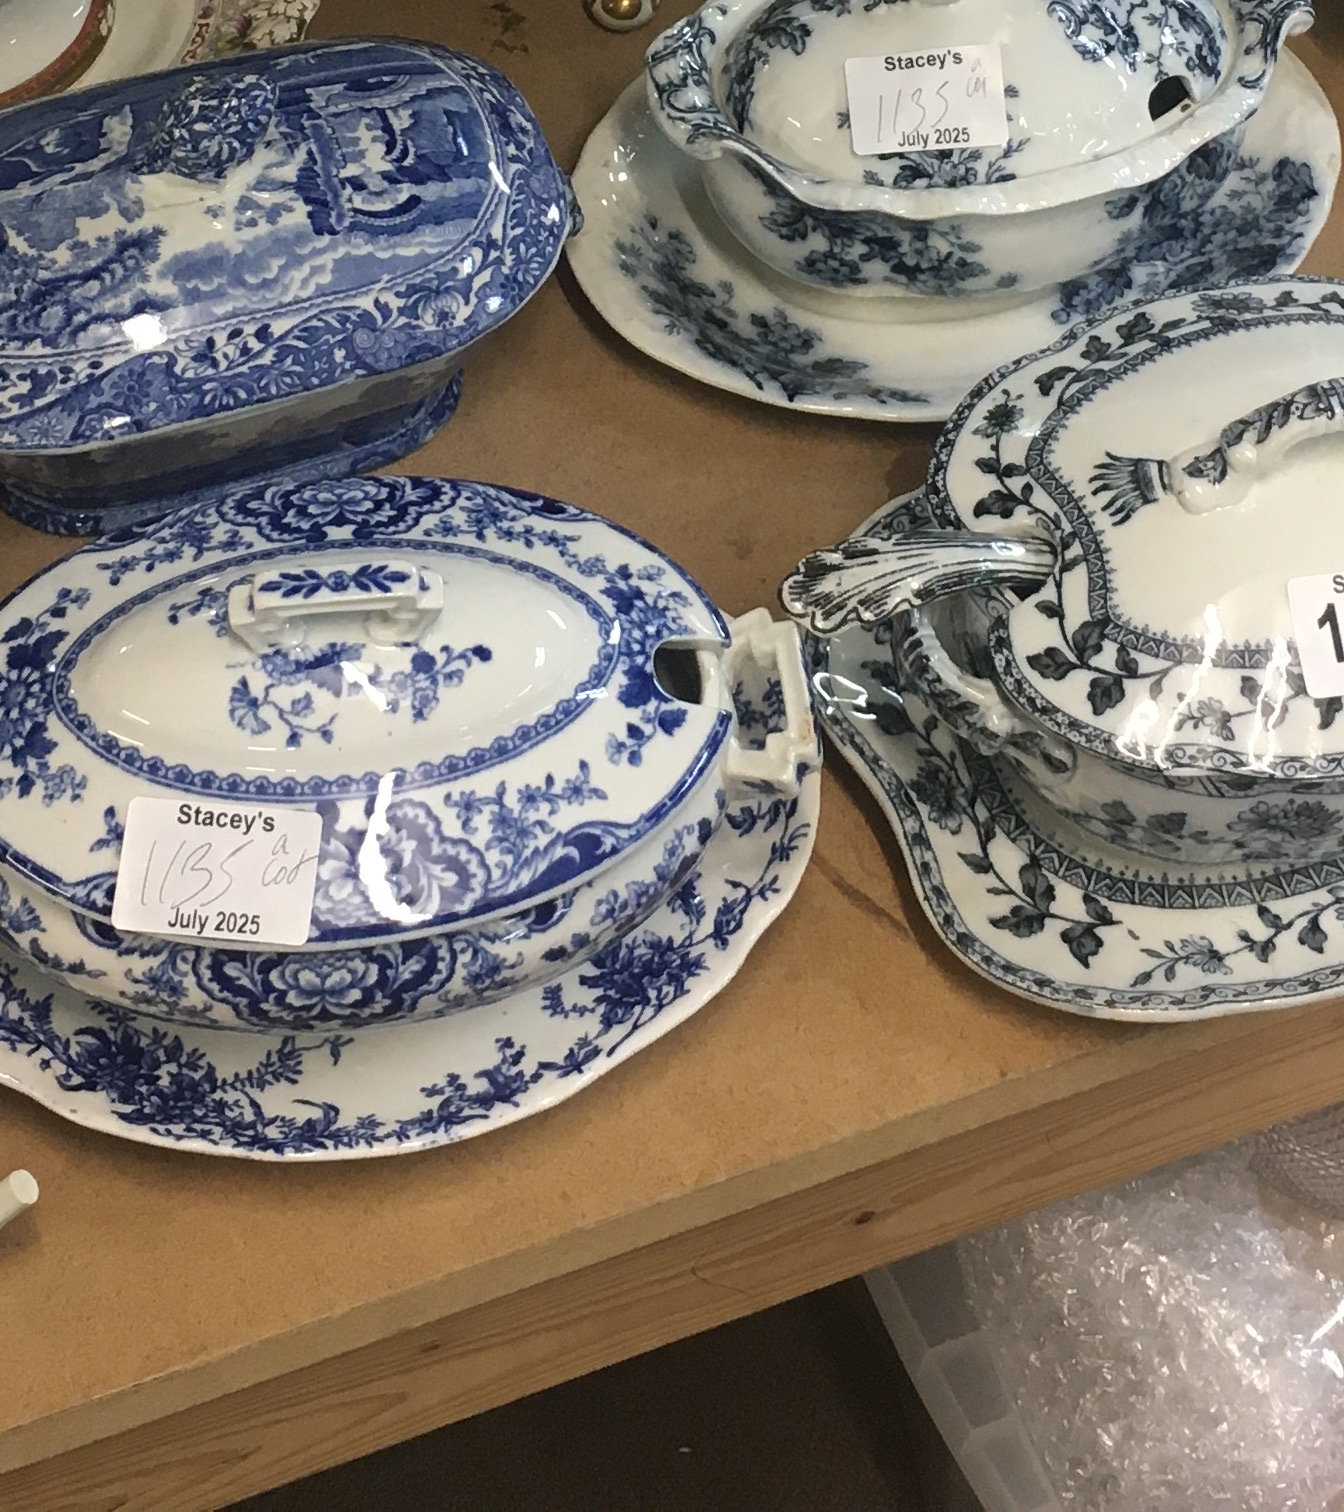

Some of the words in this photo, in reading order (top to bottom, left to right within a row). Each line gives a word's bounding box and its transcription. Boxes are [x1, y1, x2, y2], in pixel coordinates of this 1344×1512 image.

[884, 49, 963, 72] Stacey's
[877, 80, 949, 144] 1135
[898, 130, 929, 149] July
[934, 127, 970, 144] 2025
[177, 803, 276, 835] Stacey's
[167, 907, 210, 935] July
[214, 910, 261, 935] 2025
